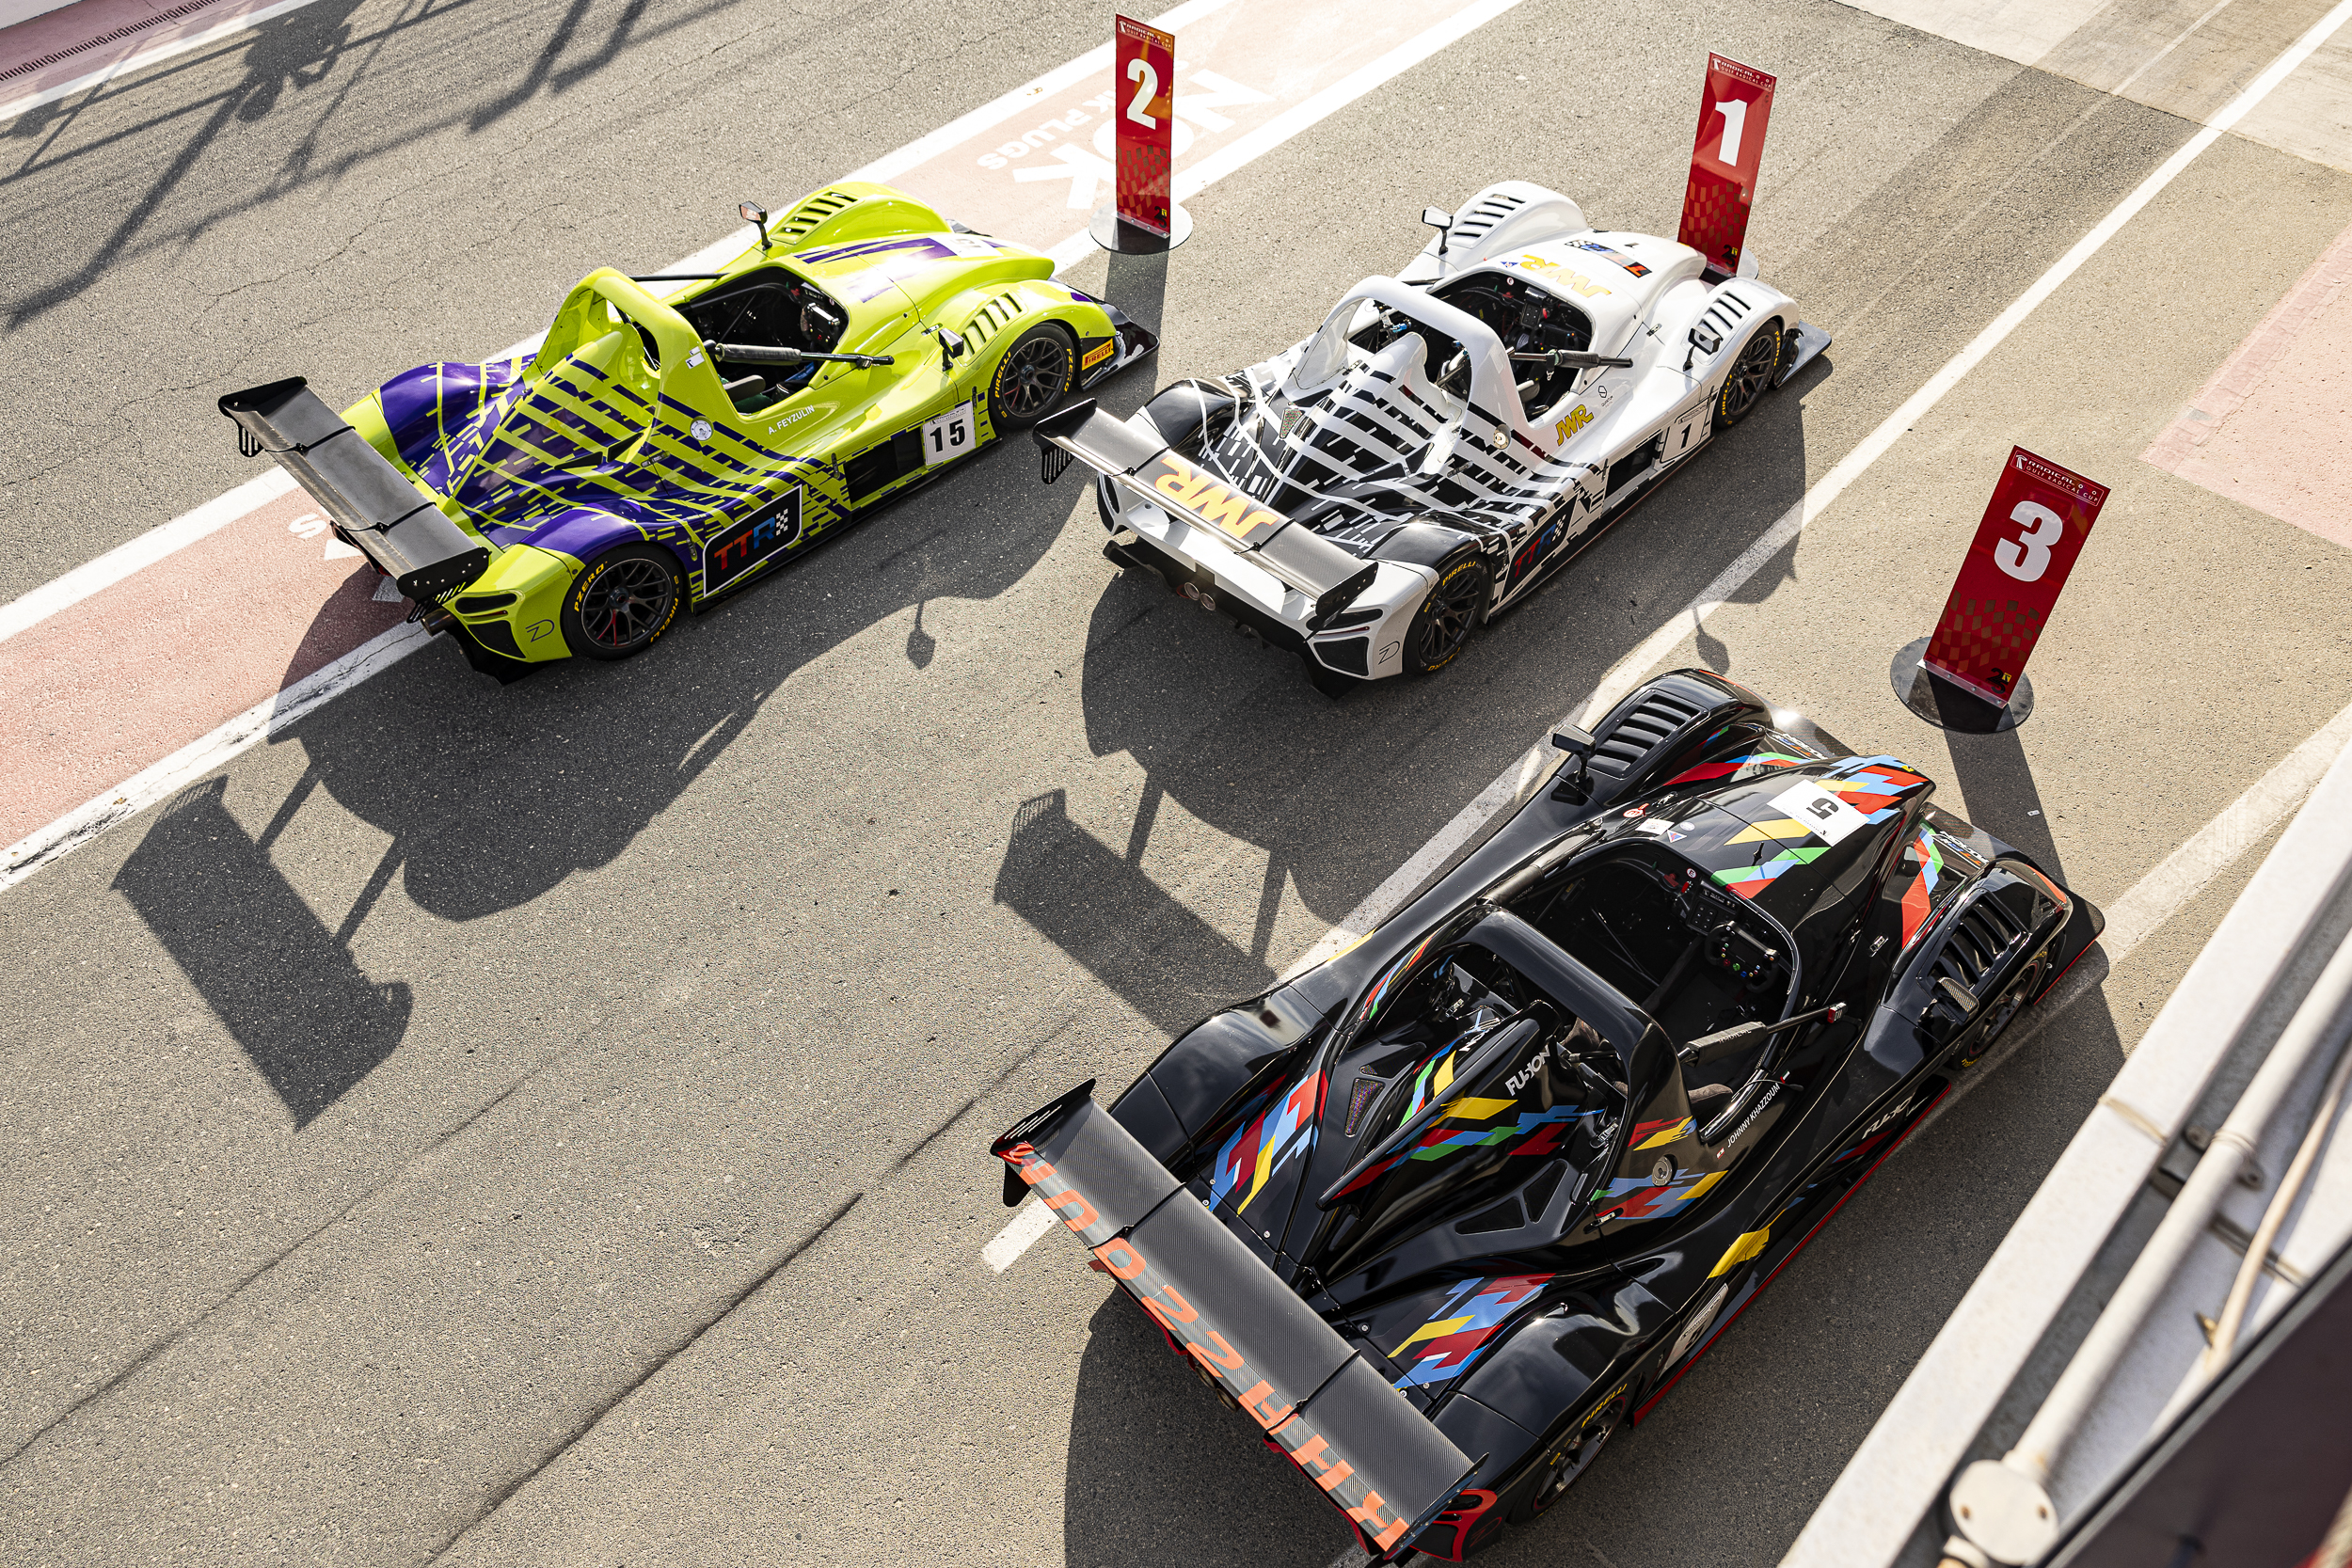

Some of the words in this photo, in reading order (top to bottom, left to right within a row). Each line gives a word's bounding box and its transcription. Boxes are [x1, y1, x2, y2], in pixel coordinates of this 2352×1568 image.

[1127, 58, 1158, 130] 2
[977, 108, 1092, 170] PLUGS
[1715, 99, 1747, 166] 1
[1520, 254, 1613, 298] JWR
[994, 352, 1011, 398] PIRELLI
[1085, 343, 1111, 366] PIRELLI
[768, 425, 777, 436] A.
[777, 405, 815, 431] FEYZULIN
[930, 419, 965, 452] 15
[1555, 404, 1595, 447] JWR
[1680, 422, 1692, 450] 1
[2026, 466, 2044, 477] GULF
[2047, 475, 2080, 494] RADICAL
[2082, 492, 2098, 502] CUP
[2028, 460, 2075, 485] RADICAL
[1155, 455, 1279, 539] JWR
[714, 516, 776, 570] TTR
[1515, 523, 1557, 578] TTR
[1994, 500, 2063, 582] 3
[1442, 562, 1476, 586] PIRELLI
[1805, 797, 1839, 820] 5
[1505, 1044, 1550, 1097] FUSION
[1727, 1117, 1751, 1148] JOHNNY
[1750, 1083, 1781, 1121] KHAZZOUM
[1581, 1384, 1628, 1428] PIRELLI
